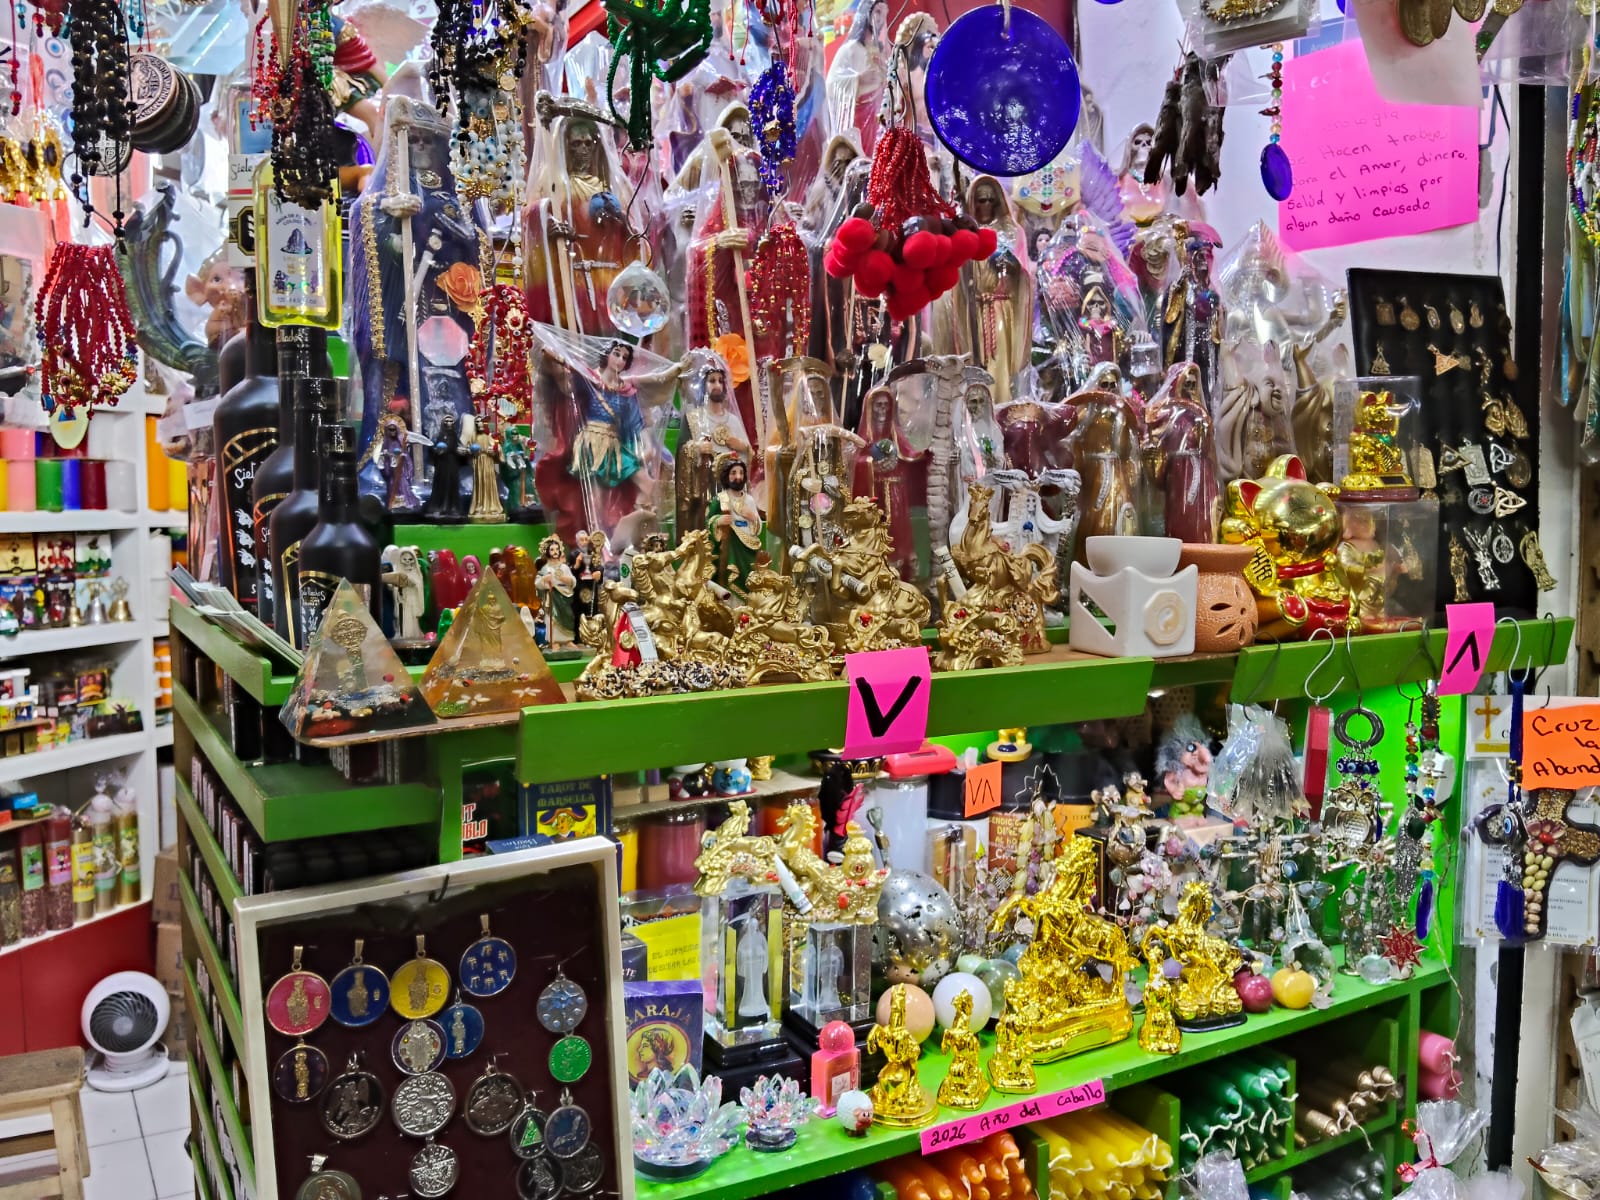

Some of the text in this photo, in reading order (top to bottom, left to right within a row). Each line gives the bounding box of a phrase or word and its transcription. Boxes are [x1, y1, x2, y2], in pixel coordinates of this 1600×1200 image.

[1329, 166, 1347, 180] el
[1419, 176, 1443, 192] por
[1532, 715, 1599, 736] Cruz
[539, 782, 576, 794] TAROT
[930, 1122, 967, 1147] 2026
[980, 1112, 1010, 1131] Año
[1020, 1102, 1042, 1118] del
